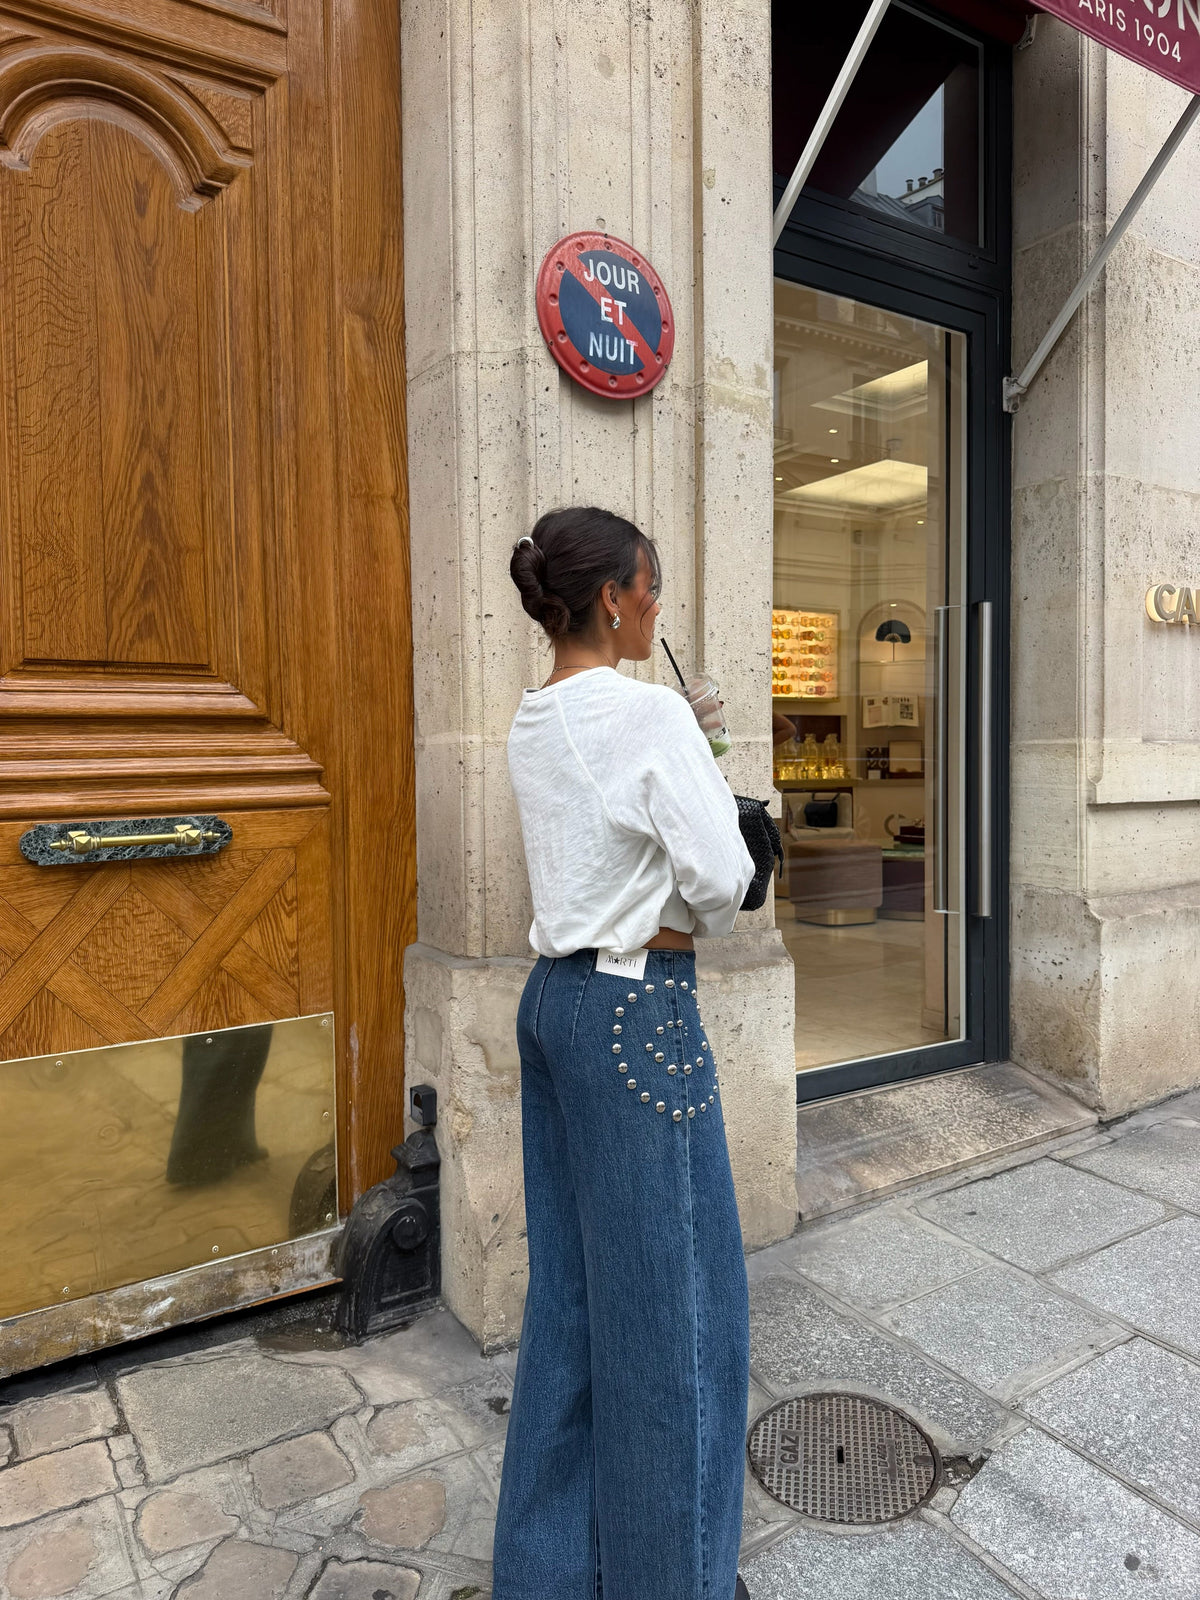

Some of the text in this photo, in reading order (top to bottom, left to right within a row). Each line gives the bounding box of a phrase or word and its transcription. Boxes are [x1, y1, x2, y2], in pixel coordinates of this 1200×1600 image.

[1134, 18, 1182, 63] 1904
[583, 258, 640, 295] JOUR
[600, 296, 627, 326] ET
[589, 331, 639, 365] NUIT
[1145, 583, 1200, 624] CA
[780, 1433, 800, 1465] GAZ
